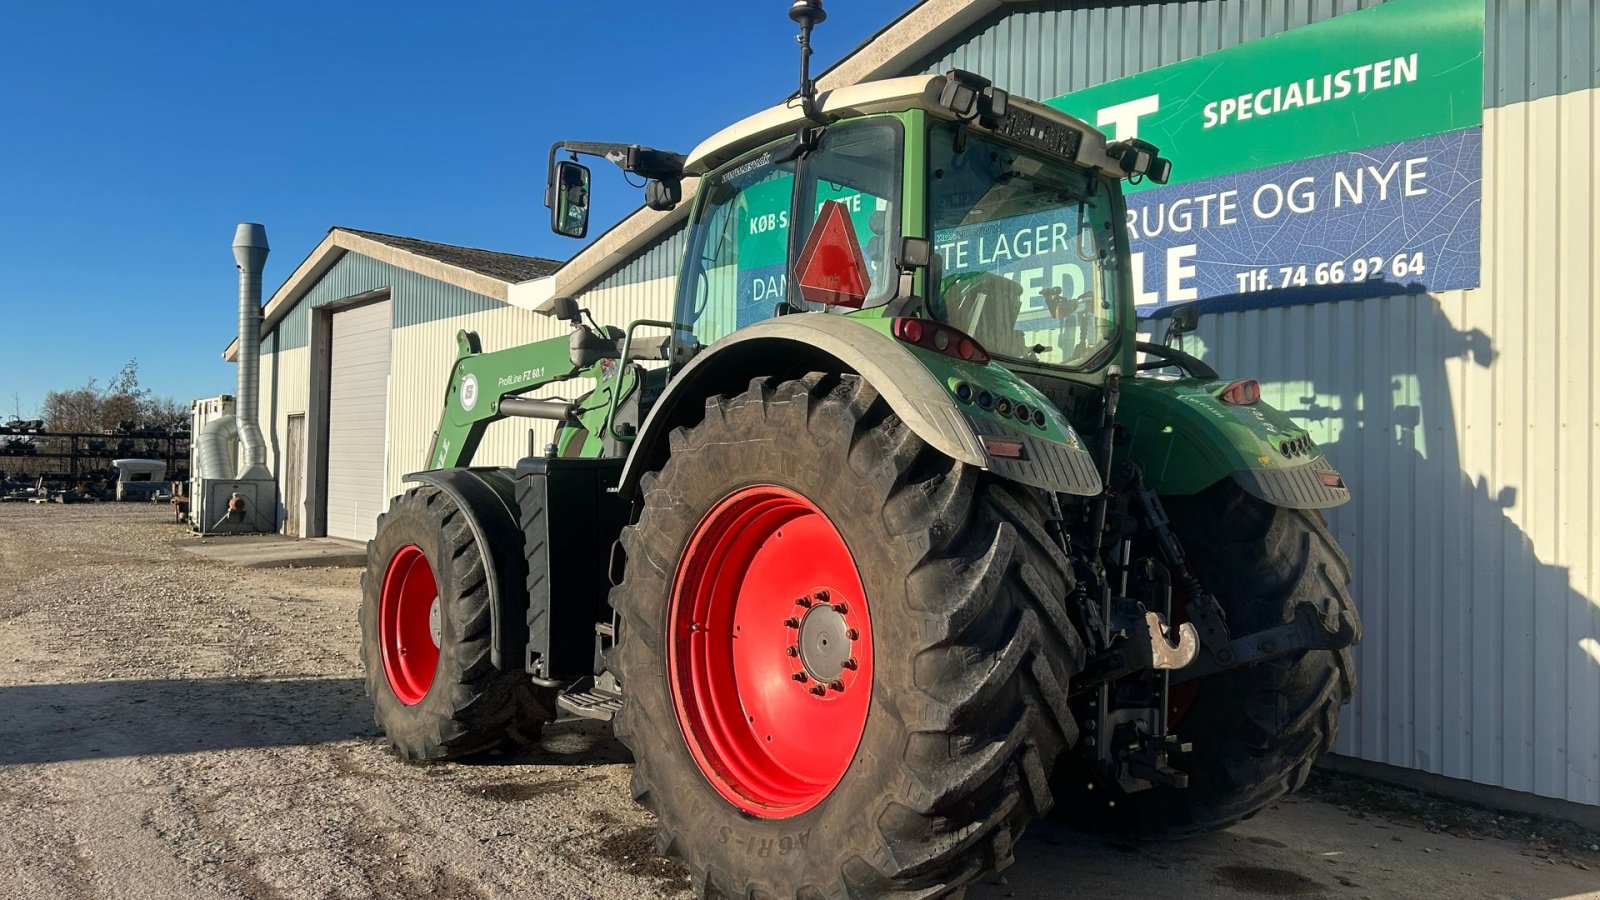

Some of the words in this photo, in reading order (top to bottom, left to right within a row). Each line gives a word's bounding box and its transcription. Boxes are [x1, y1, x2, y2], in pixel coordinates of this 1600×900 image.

[1203, 53, 1418, 129] SPECIALISTEN
[936, 240, 968, 270] TE
[979, 222, 1068, 264] LAGER
[1126, 190, 1238, 239] RUGTE
[1253, 176, 1315, 219] OG
[1334, 157, 1428, 208] NYE
[1236, 268, 1273, 293] Tlf.
[1280, 265, 1308, 289] 74
[1314, 260, 1345, 285] 66
[1352, 256, 1383, 282] 92
[1391, 252, 1425, 278] 64
